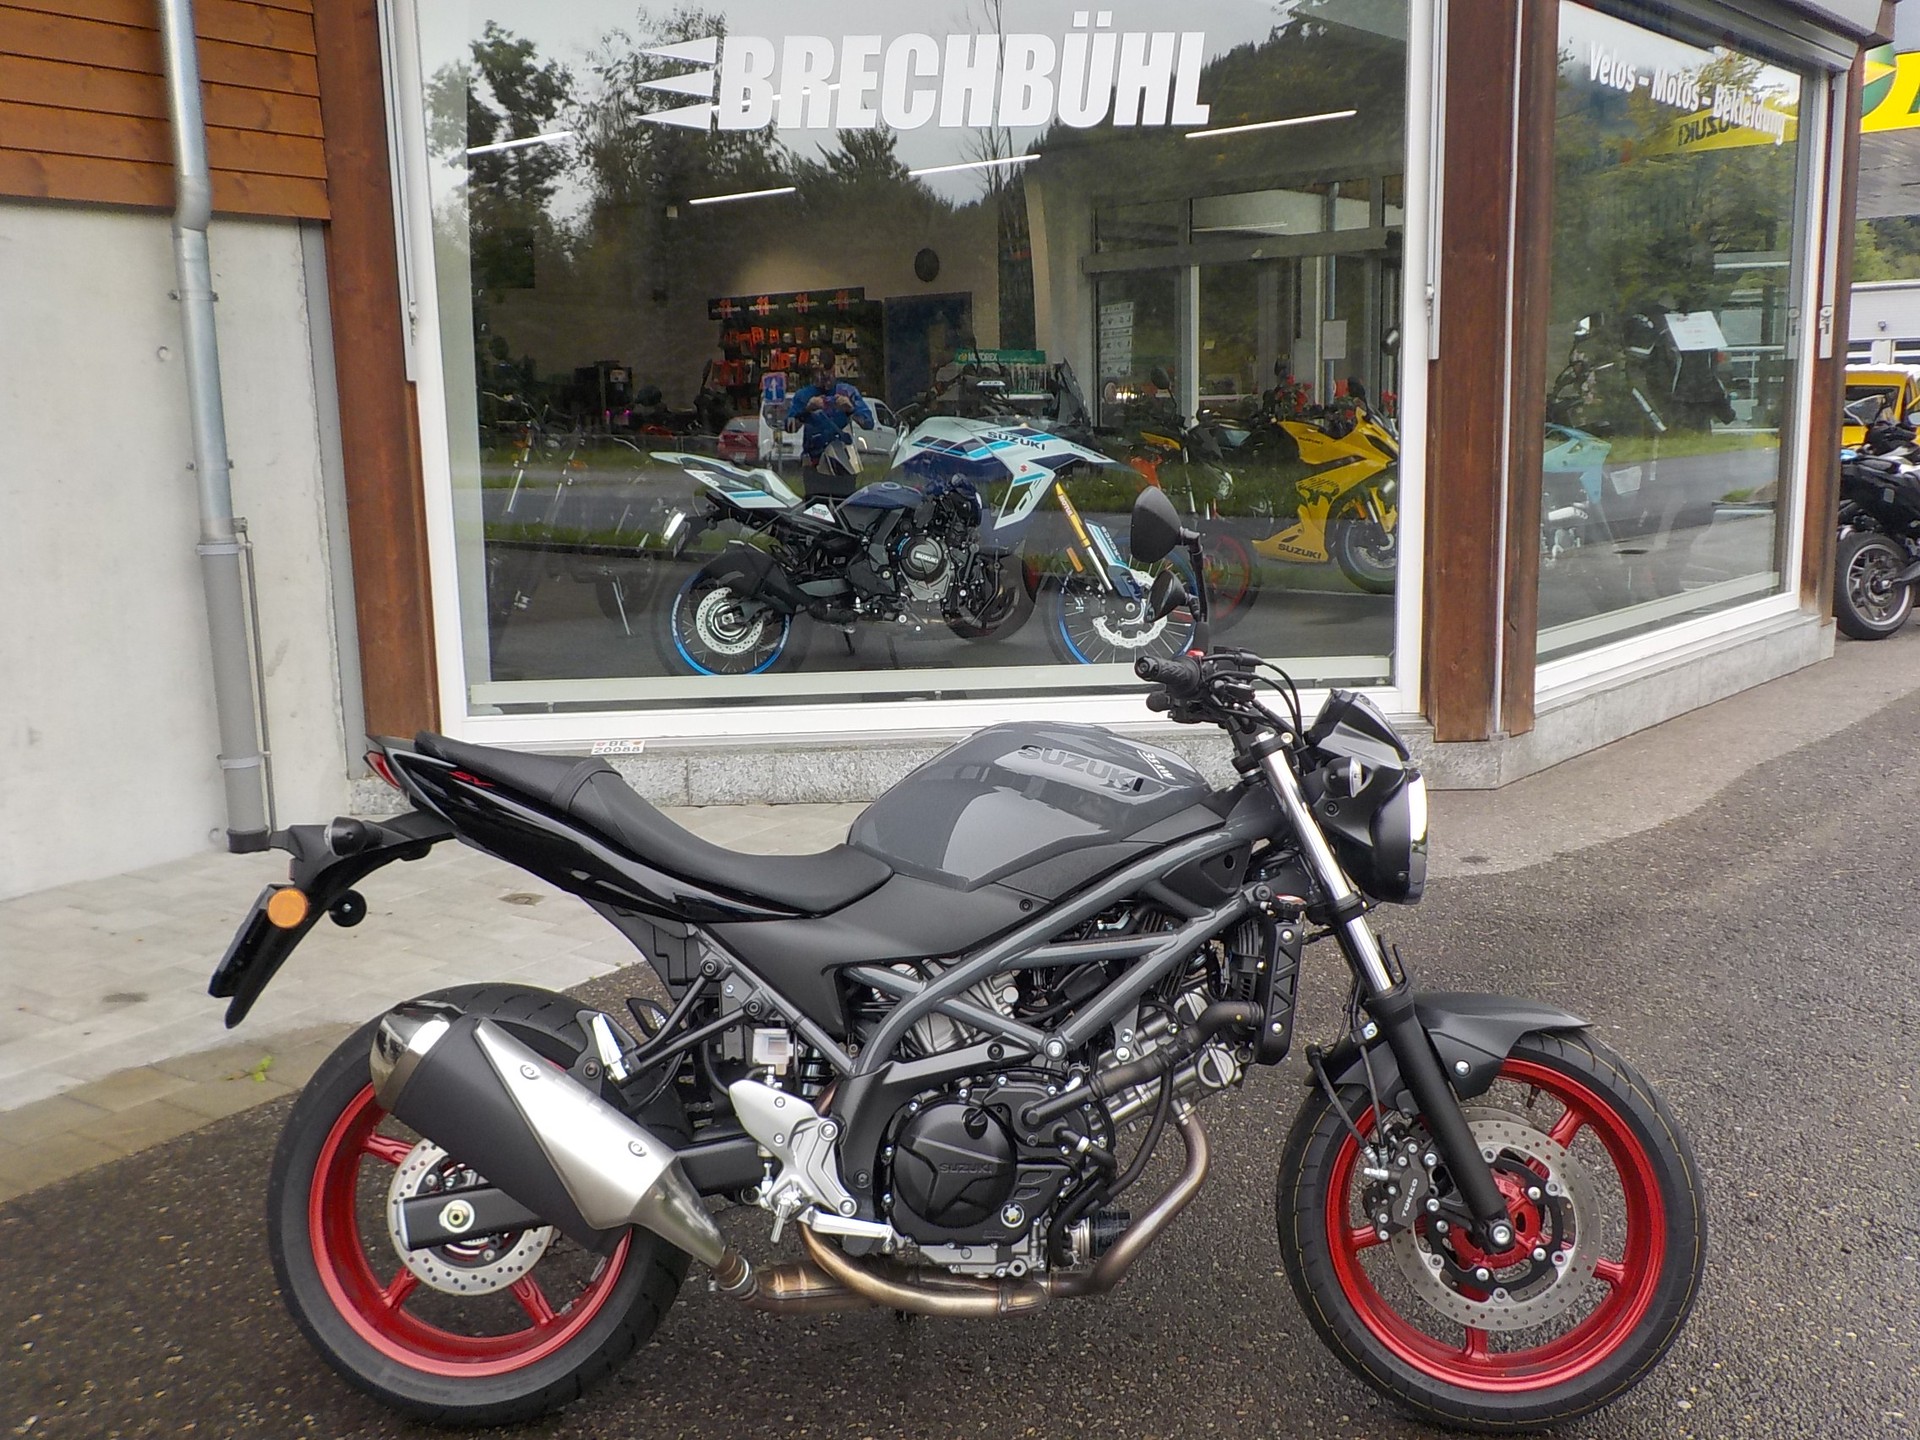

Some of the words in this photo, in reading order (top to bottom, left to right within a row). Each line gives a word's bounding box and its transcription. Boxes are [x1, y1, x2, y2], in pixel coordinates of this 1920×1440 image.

[717, 10, 1211, 130] BRECHBÜHL
[1590, 40, 1637, 93] Velos
[1651, 67, 1699, 112] Motos
[987, 430, 1046, 451] SUZUKI
[1277, 543, 1322, 560] SUZUKI
[1017, 744, 1145, 793] SUZUKI
[938, 1162, 993, 1174] SUZUKI
[1401, 1178, 1419, 1218] TOKICO
